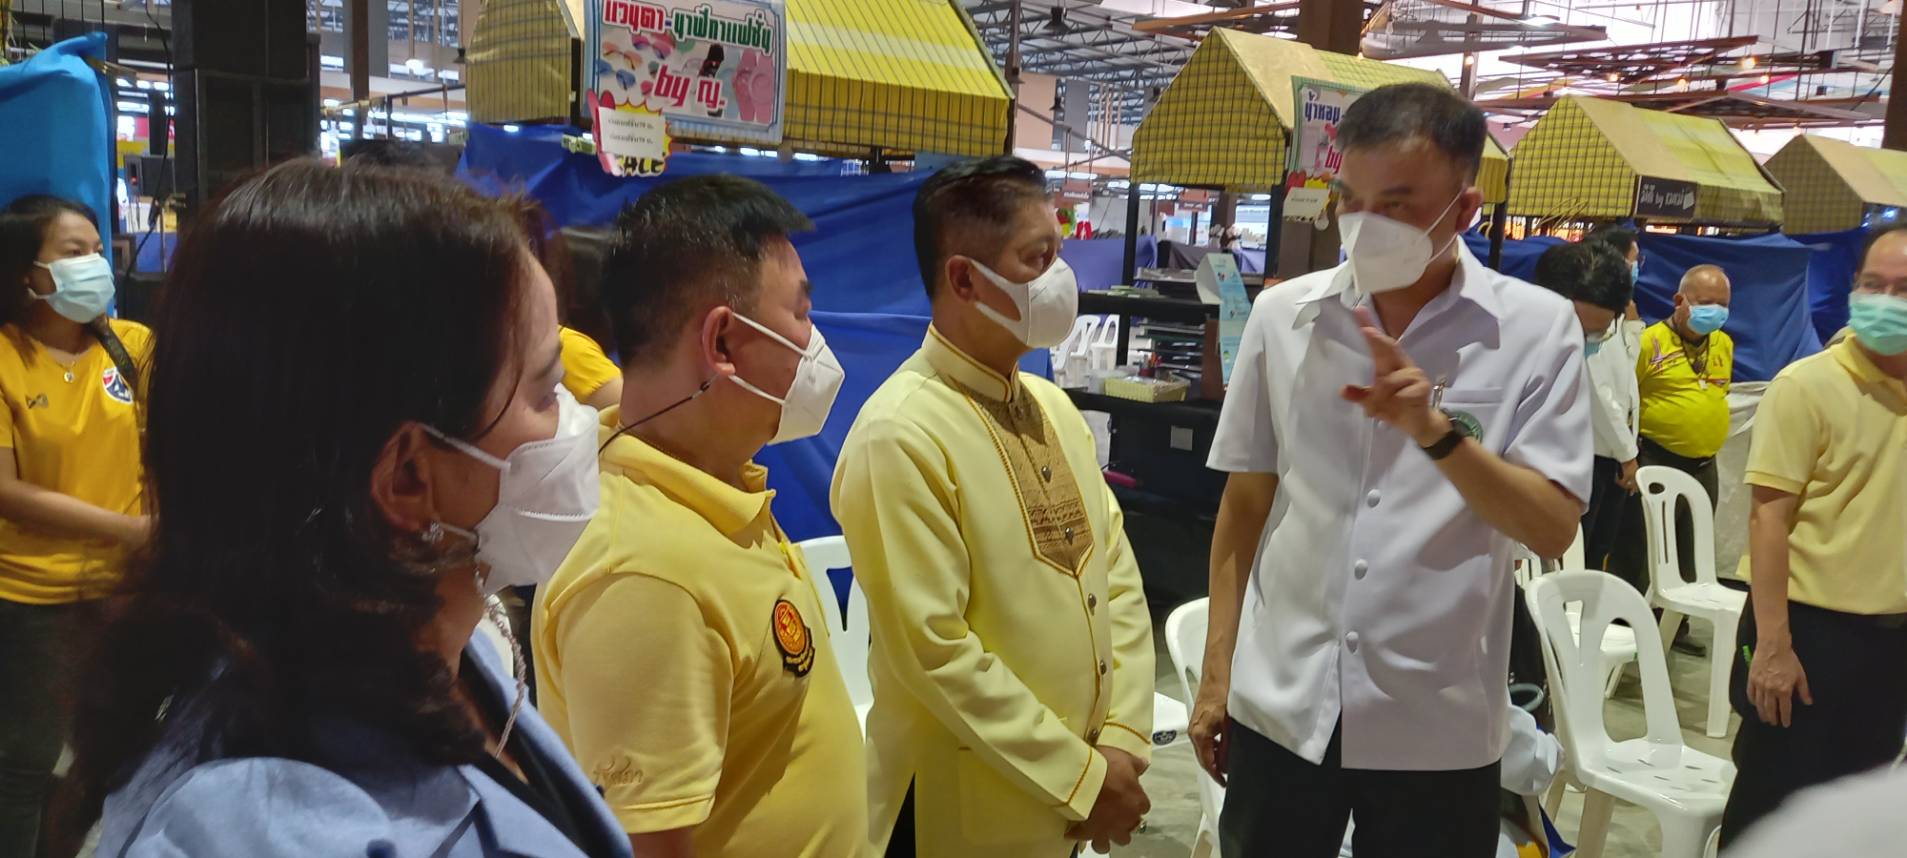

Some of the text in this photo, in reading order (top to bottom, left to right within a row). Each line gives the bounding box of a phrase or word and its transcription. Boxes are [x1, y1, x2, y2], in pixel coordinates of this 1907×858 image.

[604, 0, 772, 54] แวนตา-นาฬิกาแฟชั่น
[654, 64, 690, 107] by
